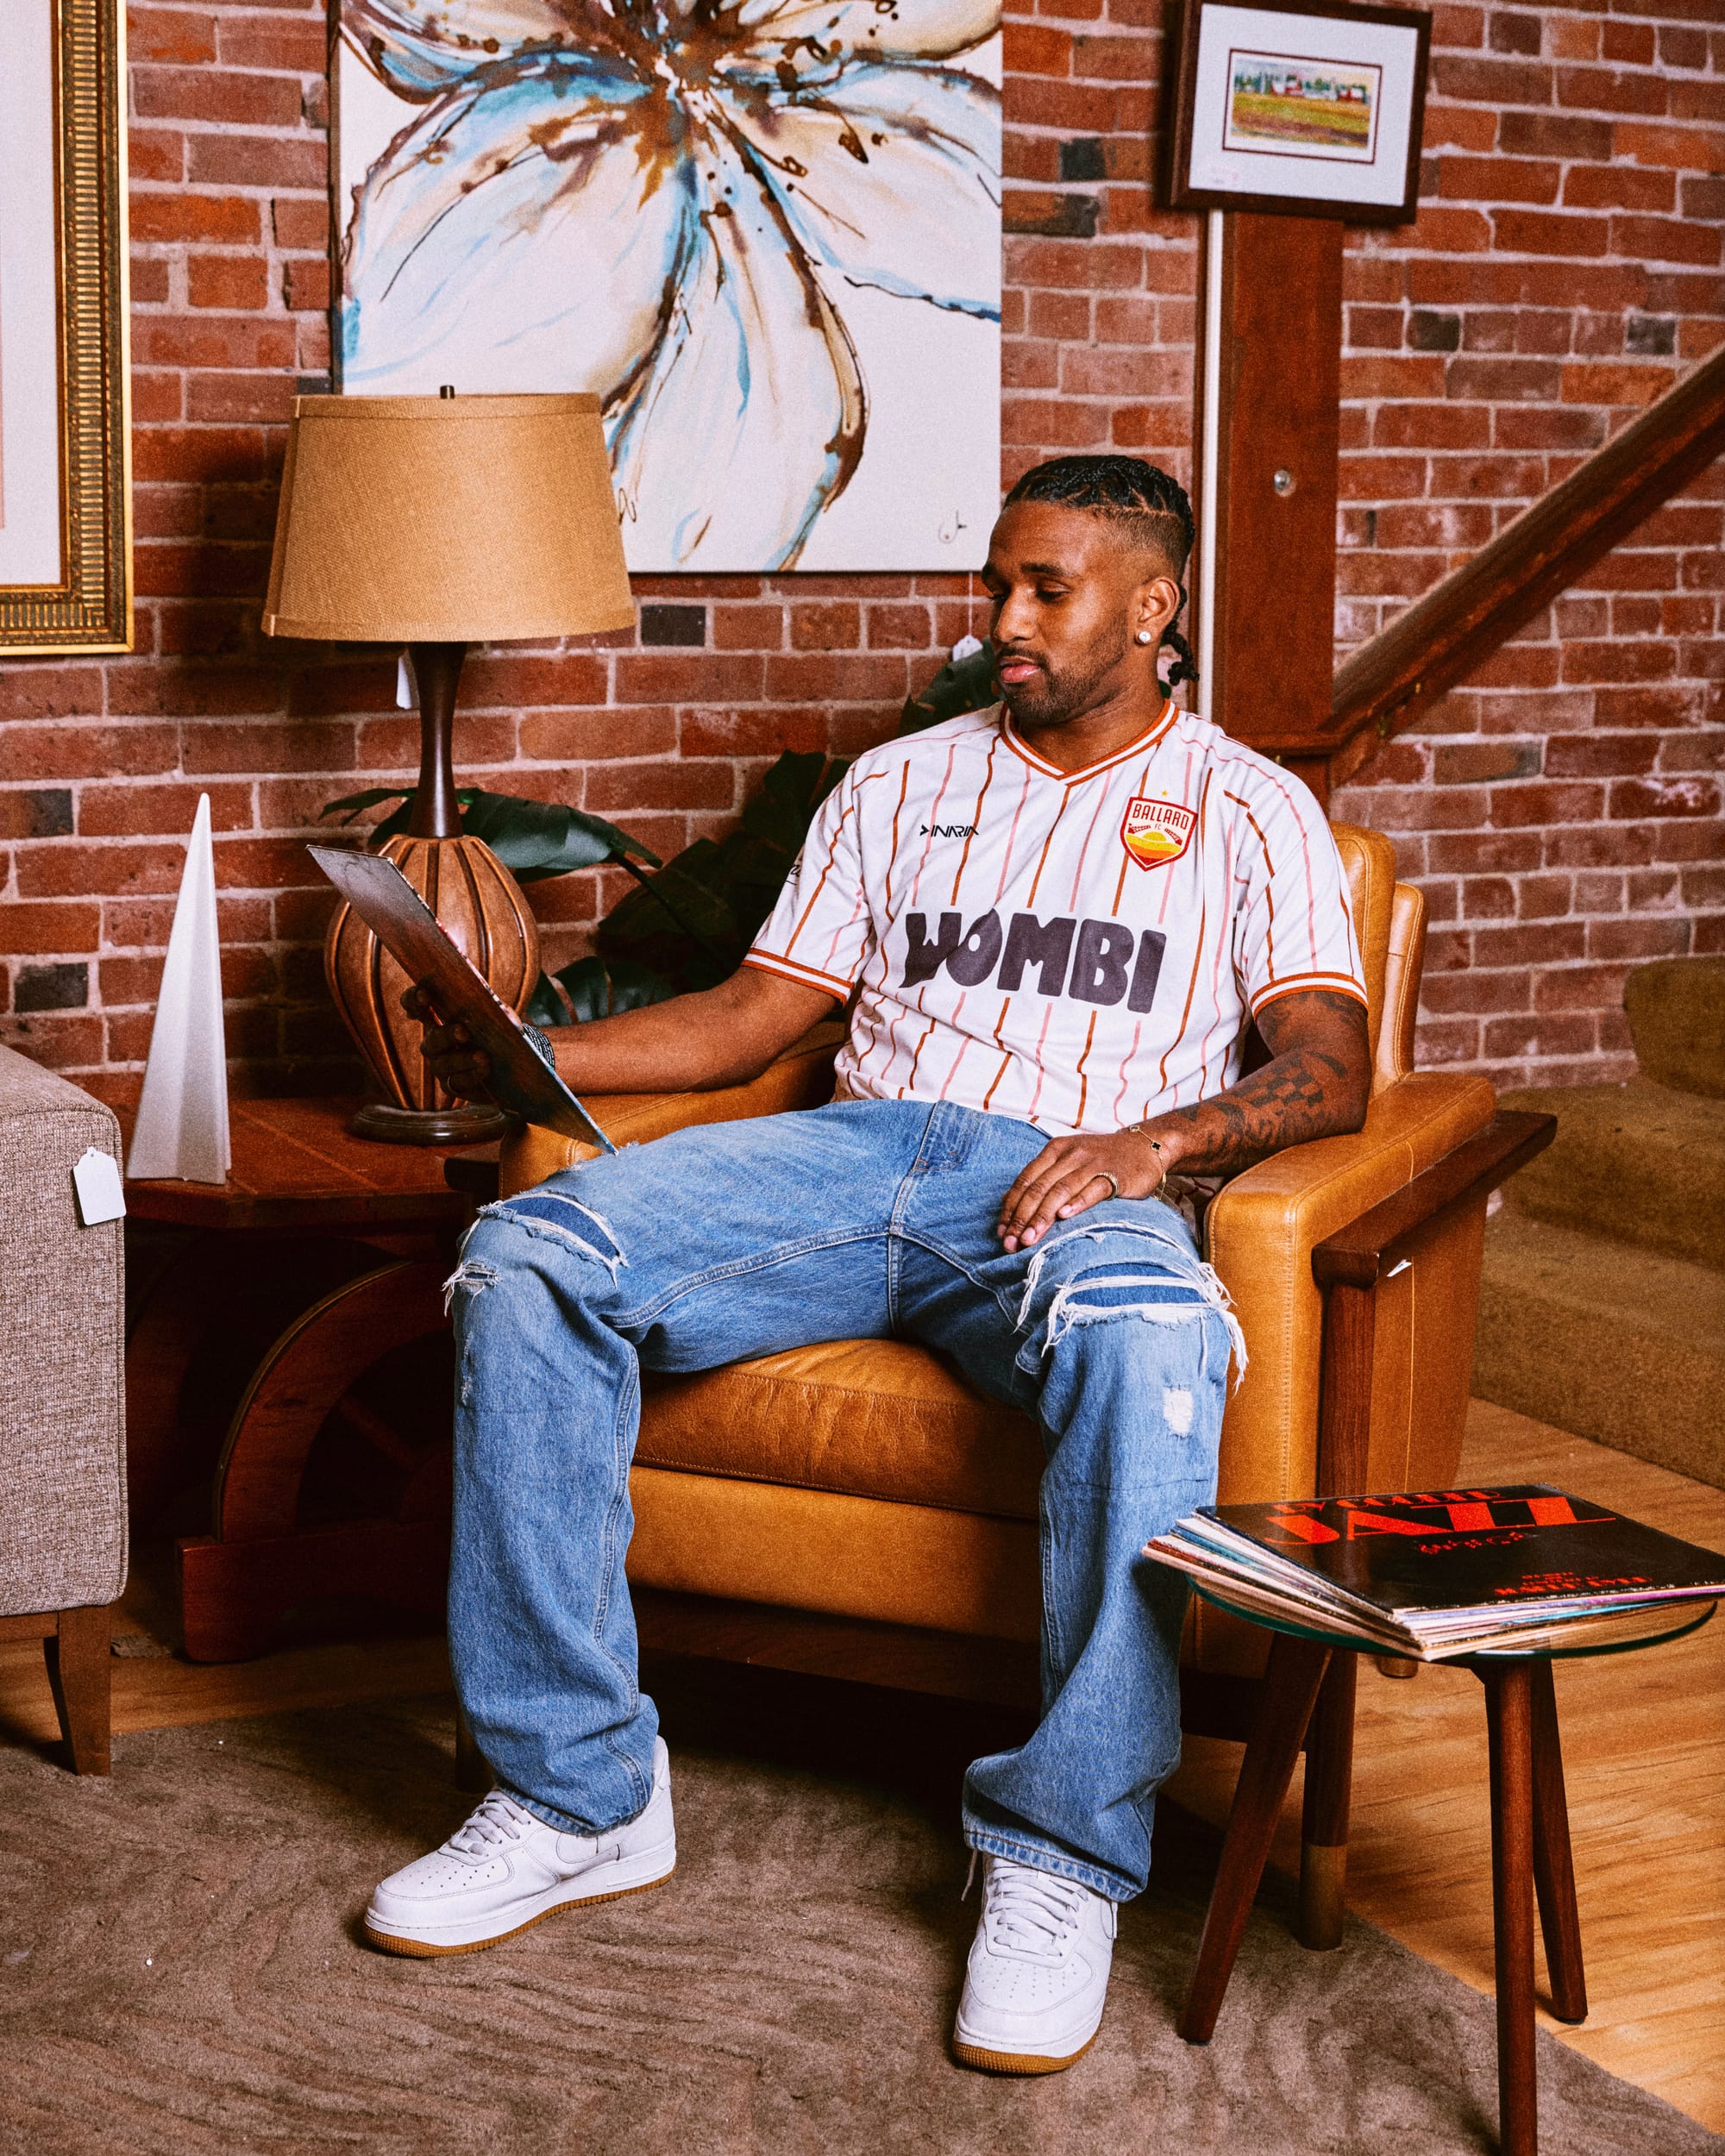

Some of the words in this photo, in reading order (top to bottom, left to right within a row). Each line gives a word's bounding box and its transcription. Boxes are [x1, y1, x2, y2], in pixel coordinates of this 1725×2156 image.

[931, 824, 979, 837] INARIA
[1132, 803, 1189, 830] BALLARD
[899, 908, 1166, 1014] WOMBI
[1264, 1496, 1616, 1545] JAZZ
